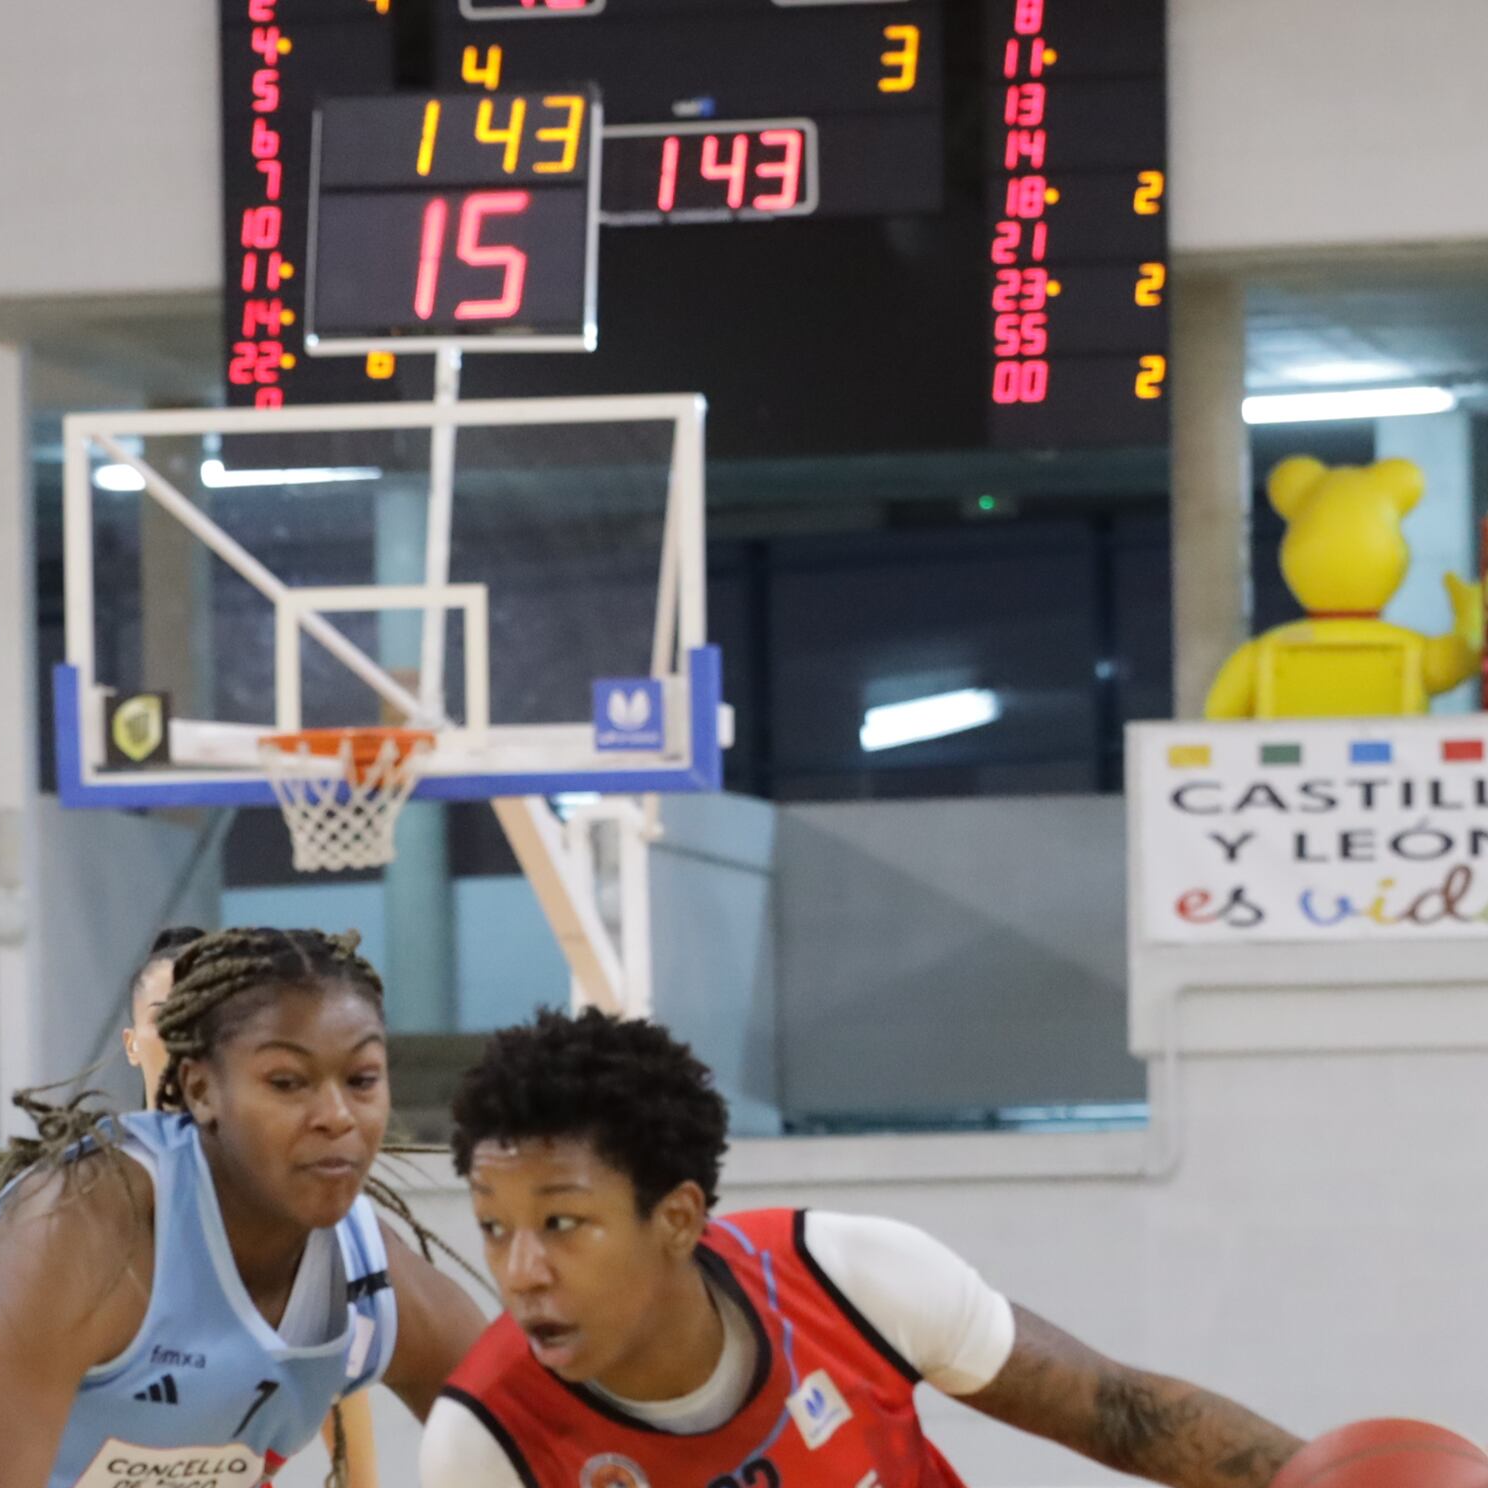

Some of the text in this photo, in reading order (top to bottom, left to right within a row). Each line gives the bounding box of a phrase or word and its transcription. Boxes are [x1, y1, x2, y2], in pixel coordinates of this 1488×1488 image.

[251, 26, 280, 66] 4
[461, 44, 502, 91] 4
[878, 25, 920, 93] 3
[1003, 37, 1045, 79] 11
[251, 69, 280, 112] 5
[1004, 82, 1046, 126] 13
[251, 117, 280, 158] 6
[1004, 128, 1046, 170] 14
[256, 159, 282, 201] 7
[1005, 175, 1047, 218] 18
[1133, 170, 1164, 215] 2
[241, 206, 282, 248] 10
[991, 220, 1048, 265] 21
[241, 251, 282, 292] 11
[414, 190, 531, 320] 15
[991, 267, 1048, 312] 23
[1134, 262, 1166, 307] 2
[242, 298, 283, 338] 14
[993, 312, 1049, 357] 55
[229, 341, 283, 385] 22
[991, 359, 1049, 404] 00
[1134, 355, 1166, 400] 2
[1211, 832, 1255, 862] Y
[1176, 888, 1266, 928] es
[106, 1457, 249, 1479] CONCELLO
